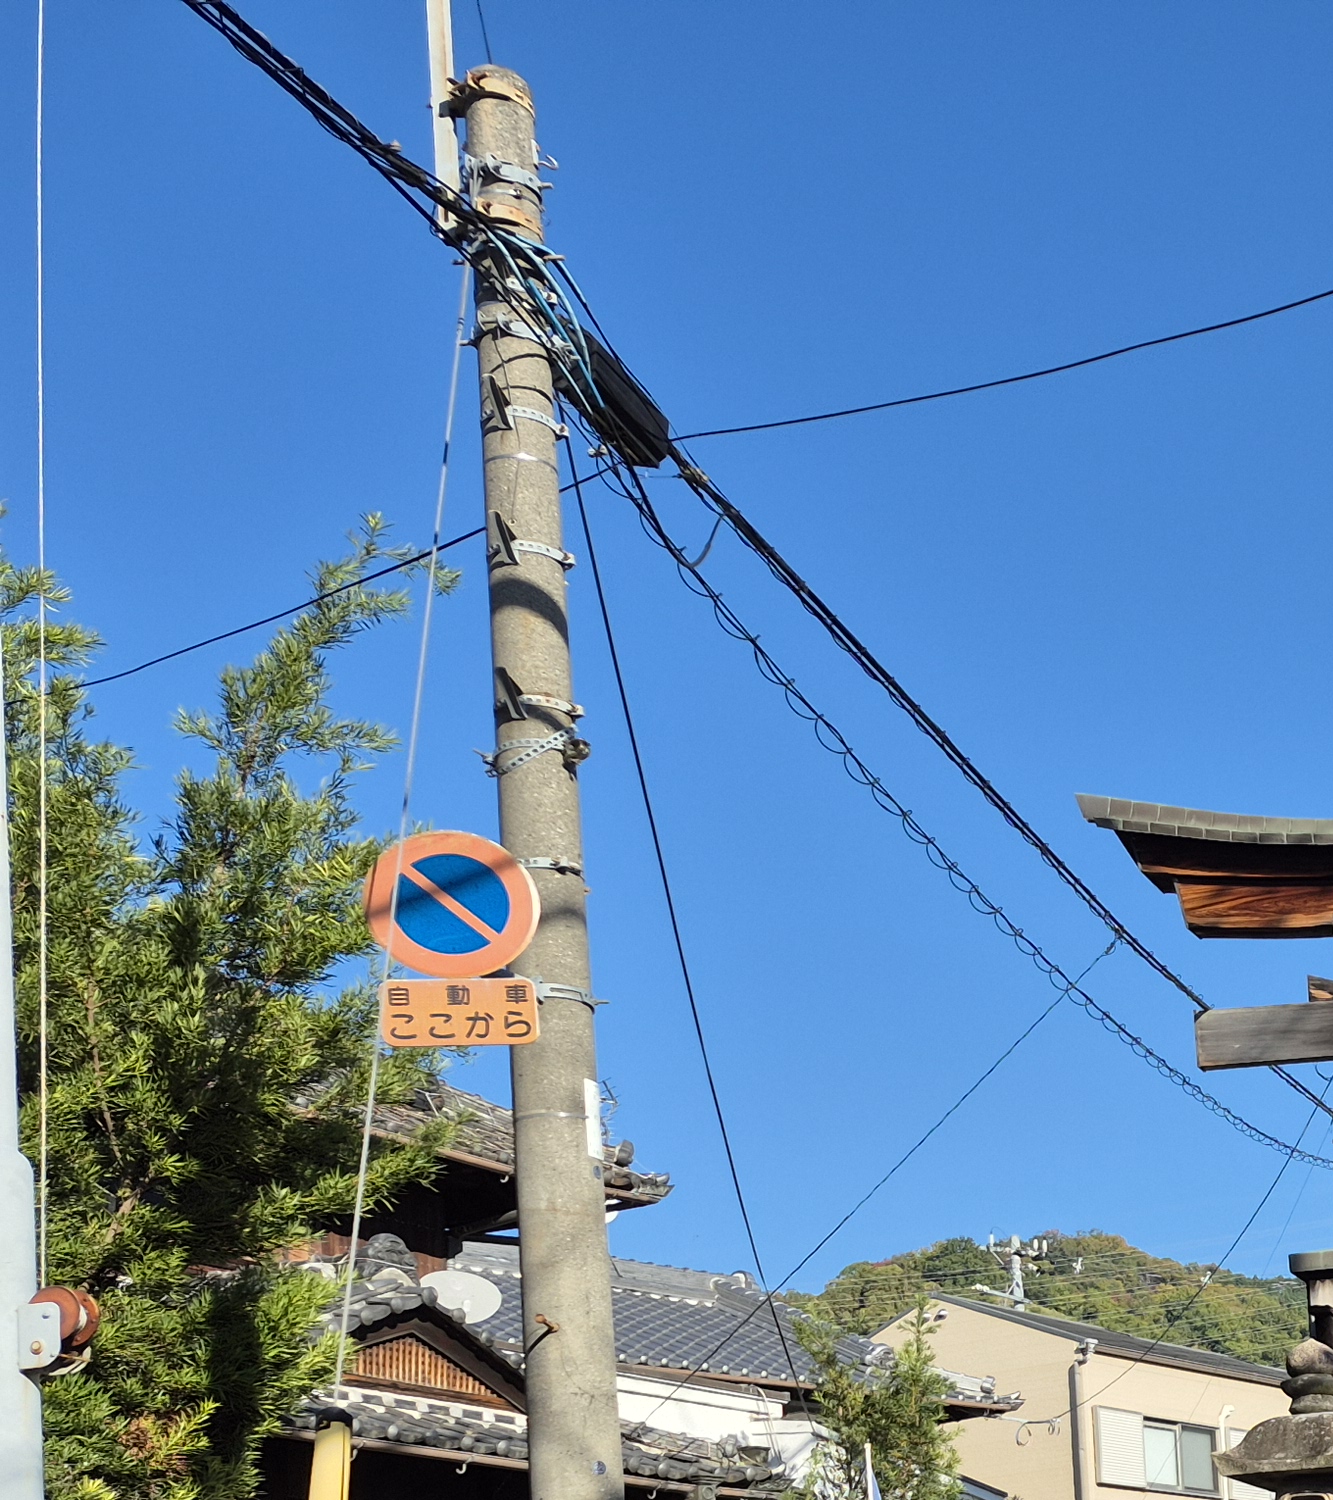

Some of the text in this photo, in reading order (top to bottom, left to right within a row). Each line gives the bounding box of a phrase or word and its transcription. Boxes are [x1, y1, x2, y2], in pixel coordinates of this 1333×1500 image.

[387, 984, 529, 1006] 自動車
[389, 1010, 532, 1040] ここから
